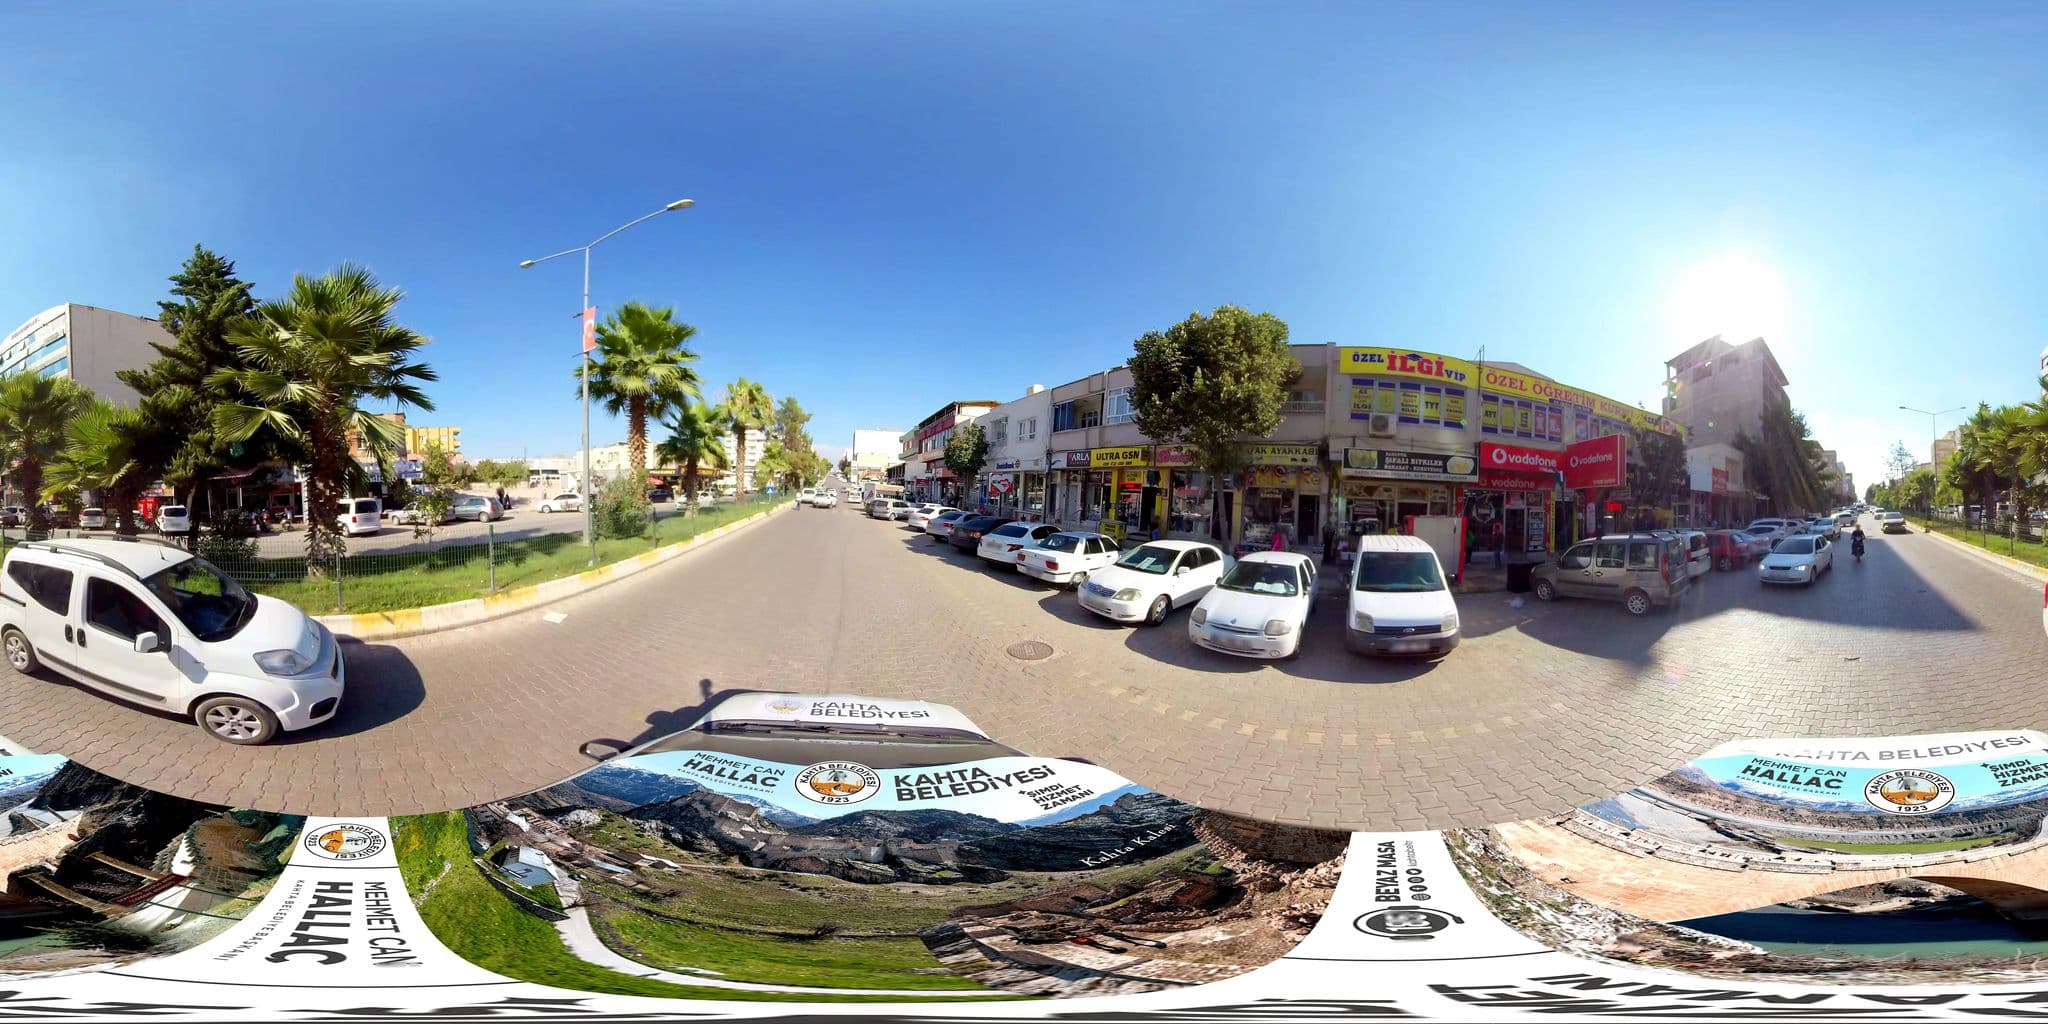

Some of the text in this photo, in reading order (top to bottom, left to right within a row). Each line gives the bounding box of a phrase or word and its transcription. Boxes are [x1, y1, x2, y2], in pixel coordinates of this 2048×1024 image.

[1352, 352, 1384, 363] ÖZEL
[1386, 351, 1445, 377] İLGİ
[1486, 370, 1528, 391] ÖZEL
[1425, 401, 1439, 410] TYT
[1096, 453, 1120, 461] ULTRA
[1508, 454, 1557, 467] vodafone
[1579, 453, 1613, 465] vodafone
[1491, 479, 1535, 488] vodafone
[812, 702, 880, 710] KAHTA
[694, 752, 786, 776] MEHMET CAN
[1751, 758, 1847, 777] MEHMET CAN
[800, 765, 826, 784] KAHTA
[894, 767, 991, 787] KAHTA
[1869, 773, 1894, 794] KAHTA
[1040, 789, 1094, 810] ZAMANI
[340, 825, 373, 835] KAHTA
[1079, 823, 1176, 866] Kahta Kalesi
[1375, 841, 1401, 902] BEYAZ MASA
[364, 882, 423, 966] MEHMET CAN
